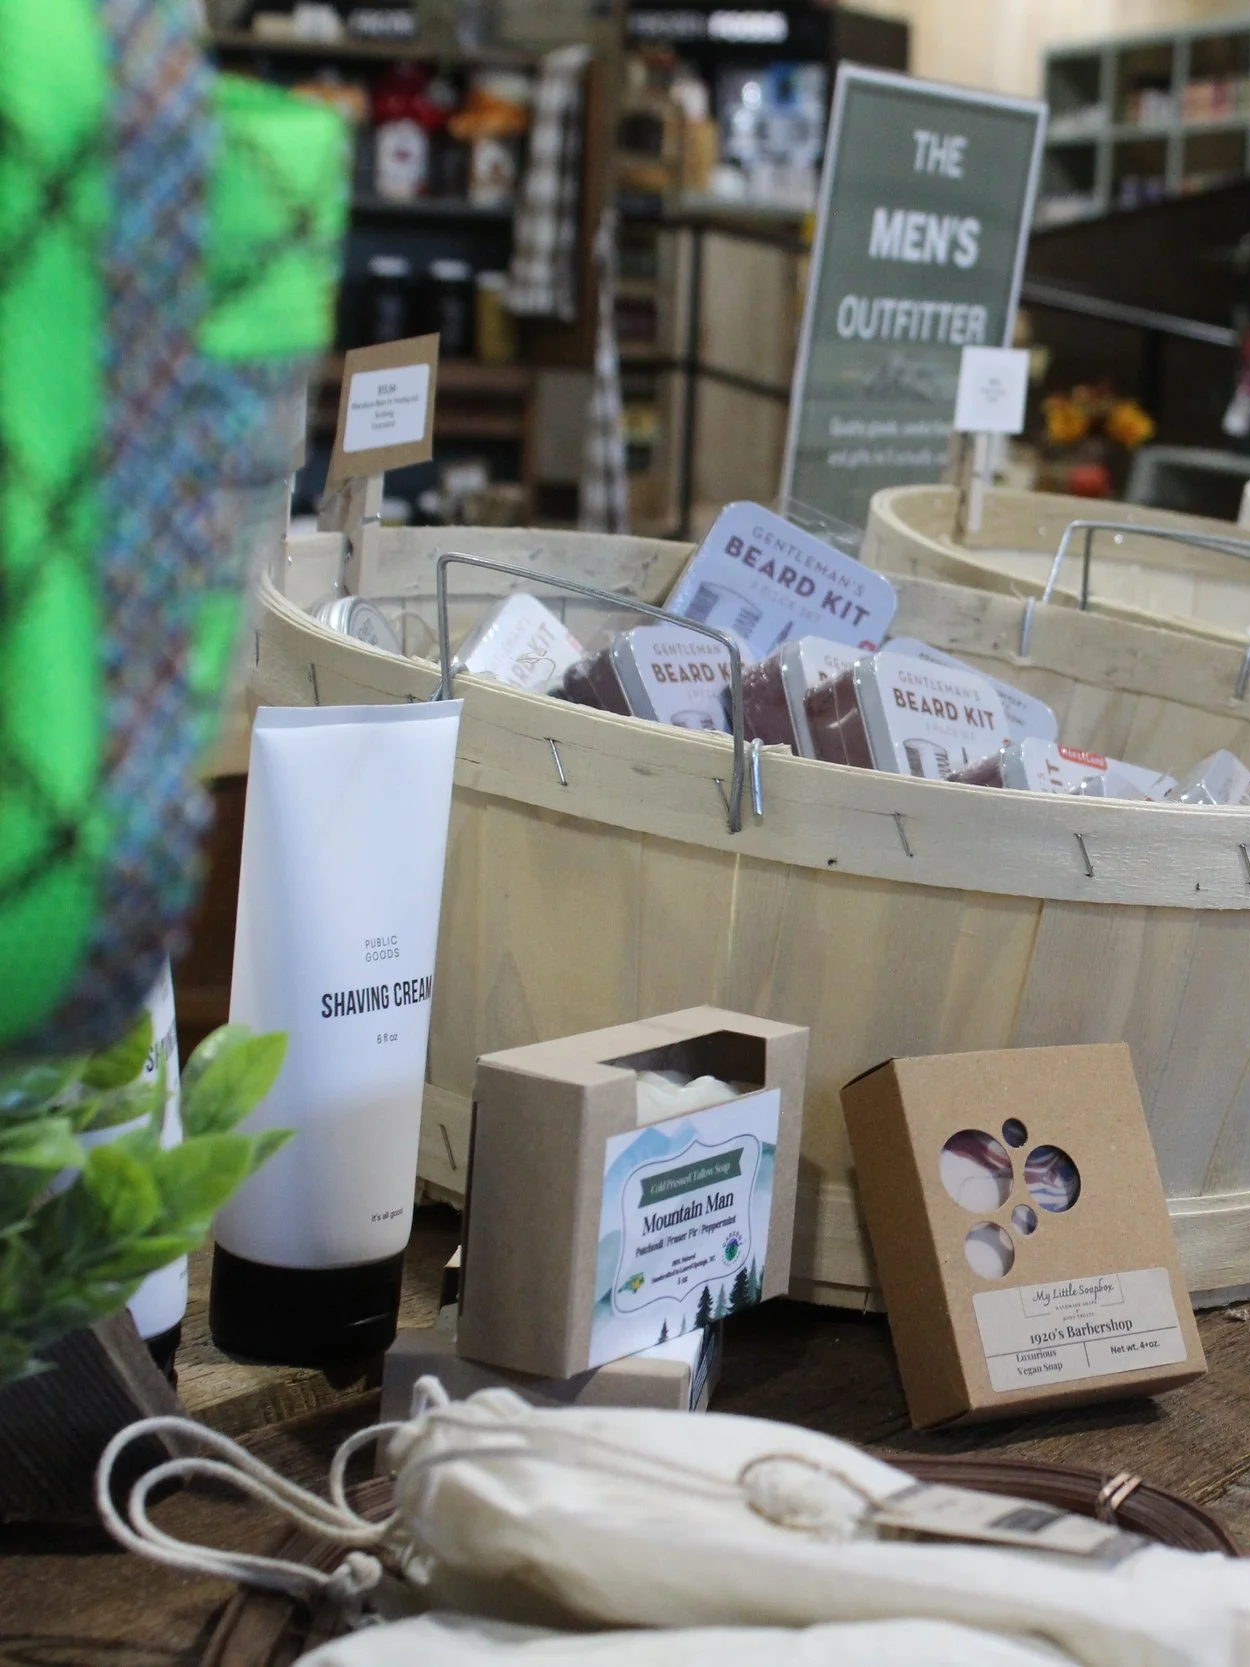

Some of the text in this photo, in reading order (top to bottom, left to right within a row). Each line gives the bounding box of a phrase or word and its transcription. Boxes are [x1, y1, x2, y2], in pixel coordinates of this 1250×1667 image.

[913, 129, 969, 179] THE
[869, 207, 982, 269] MEN'S
[836, 294, 989, 346] OUTFITTER
[751, 525, 867, 598] GENTLEMAN'S
[723, 535, 872, 628] BEARD KIT
[651, 662, 715, 684] BEARD
[897, 670, 981, 703] GENTLEMAN'S
[892, 687, 960, 721] BEARD
[964, 706, 996, 731] KIT
[364, 935, 398, 949] PUBLIC
[365, 947, 400, 963] GOODS
[321, 974, 433, 1019] SHAVING CREAM
[376, 1034, 382, 1045] 6
[389, 1032, 398, 1043] oz
[715, 1162, 731, 1175] Soap
[390, 1208, 404, 1220] good
[642, 1191, 735, 1237] Mountain Man
[667, 1232, 688, 1247] Fraser
[688, 1227, 698, 1240] Fir
[701, 1215, 737, 1235] Peppermint
[1033, 1277, 1115, 1307] My Little Soapbox
[1029, 1318, 1133, 1346] 1920's Barbershop
[1015, 1348, 1057, 1363] Luxurious
[1110, 1346, 1125, 1355] Net
[1126, 1344, 1139, 1352] wt.
[1016, 1361, 1063, 1377] Vegan Soap
